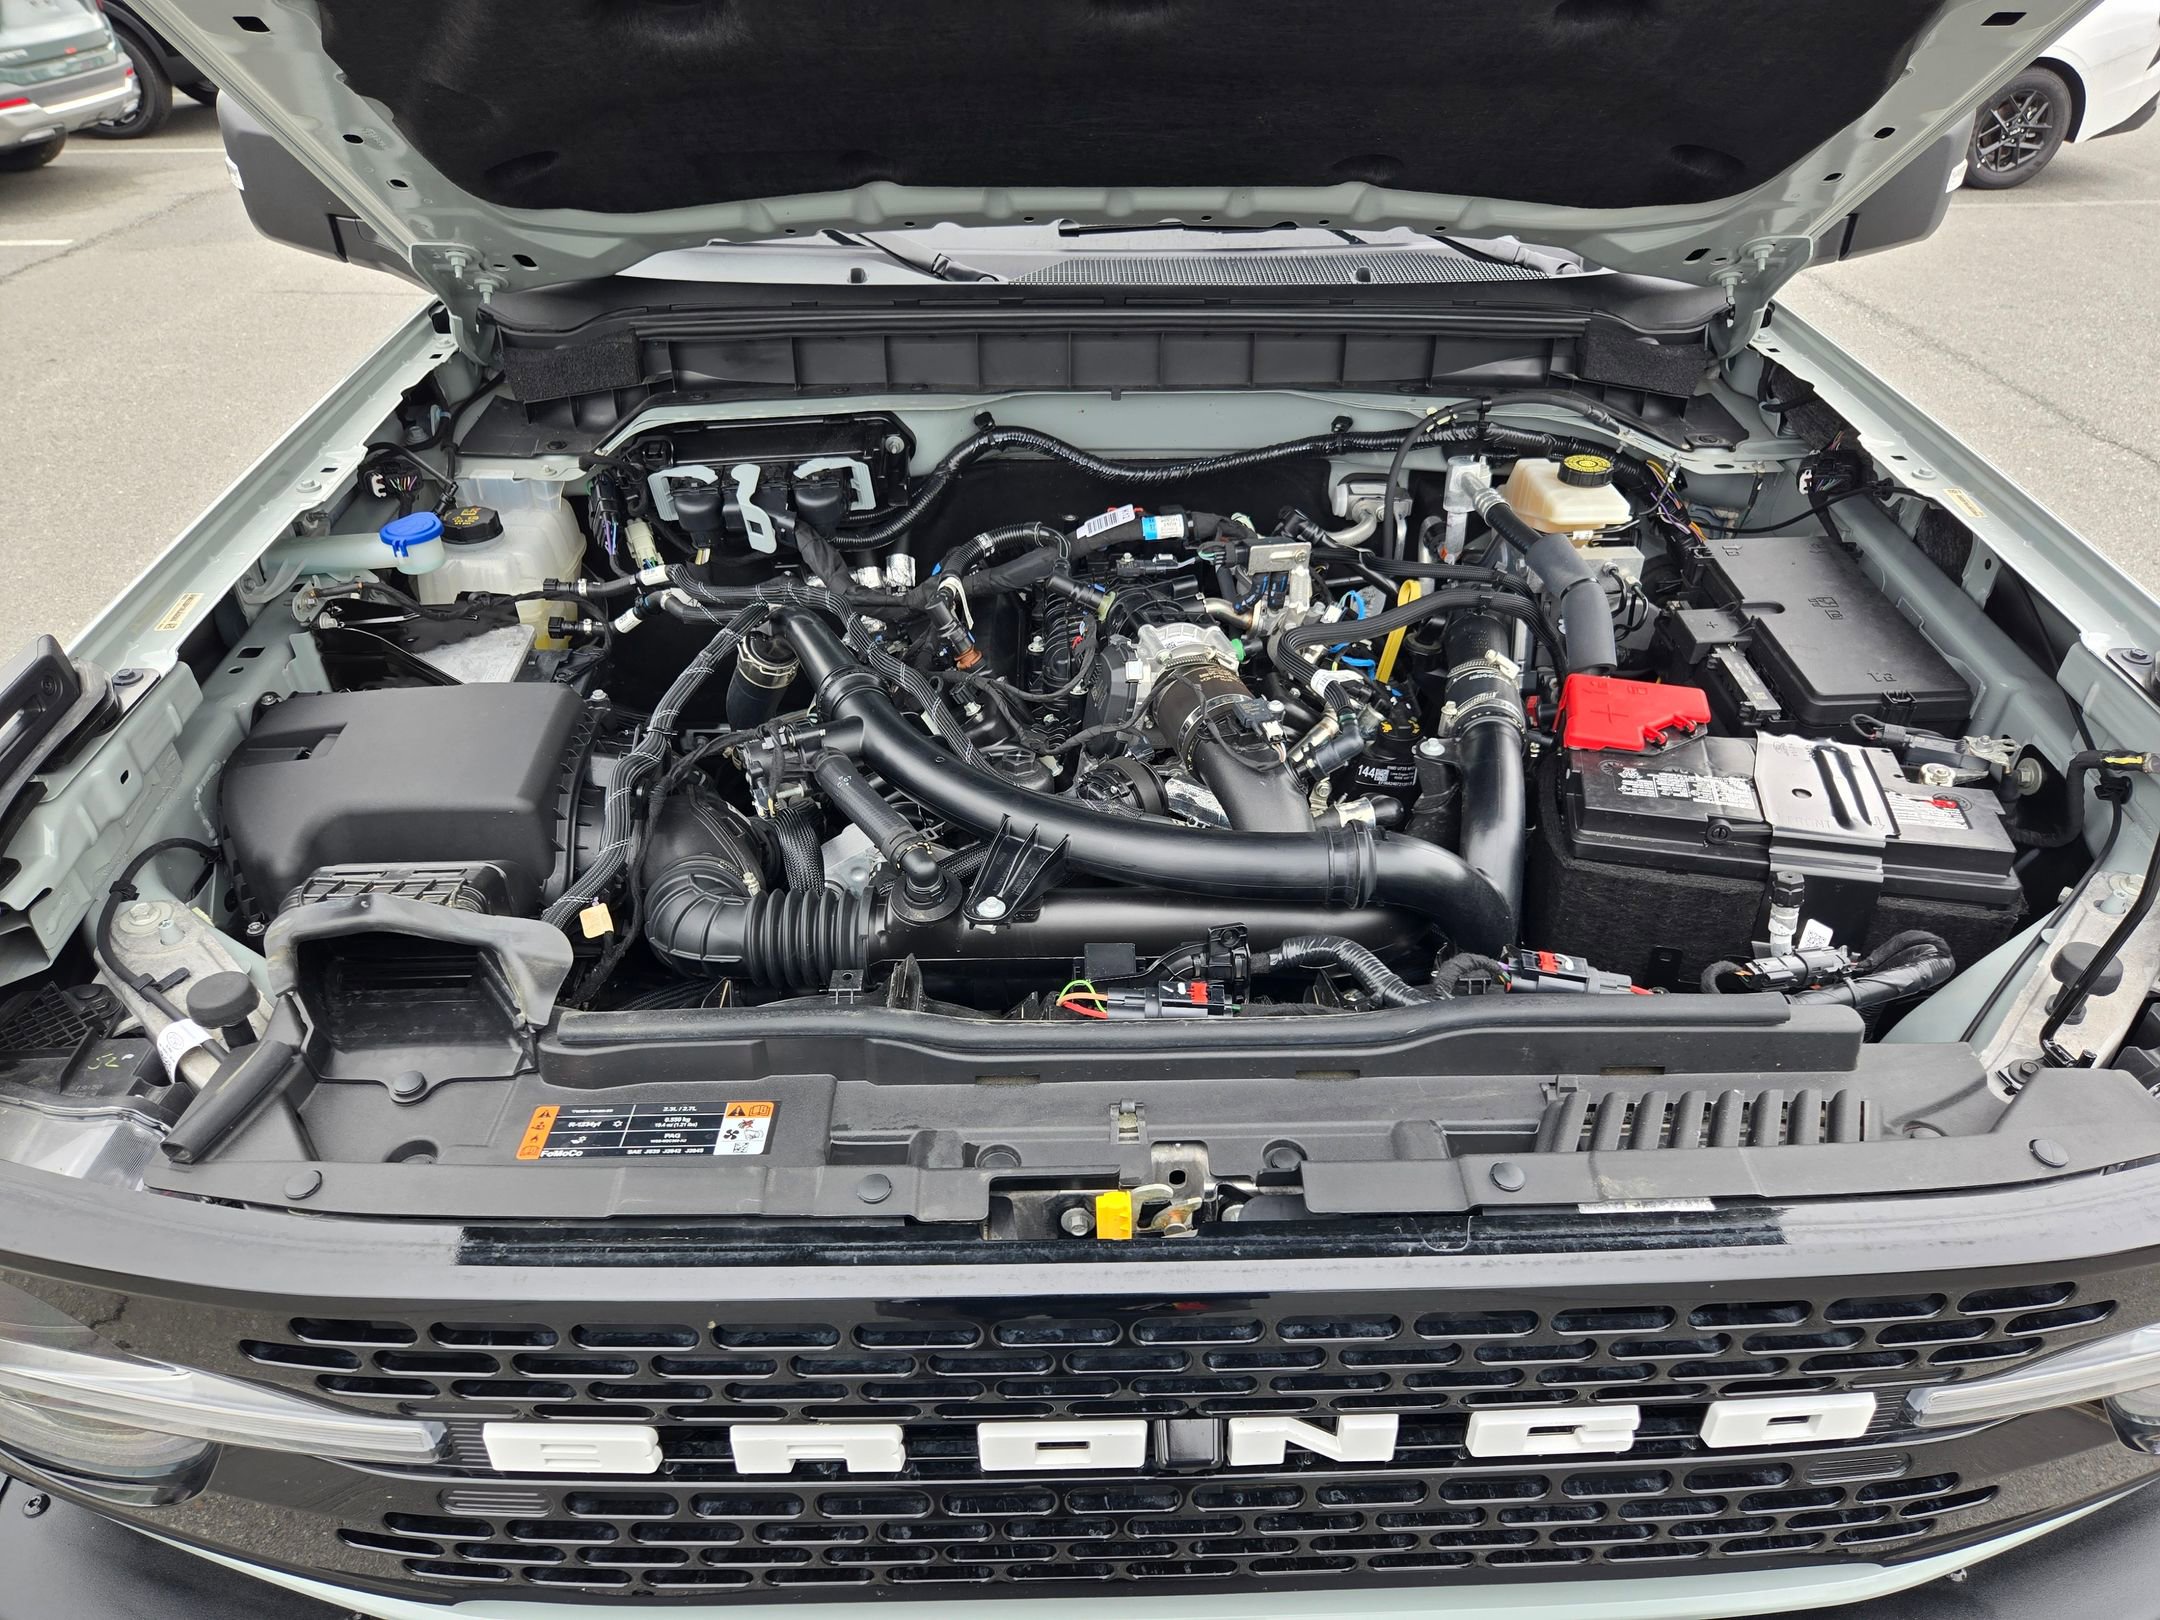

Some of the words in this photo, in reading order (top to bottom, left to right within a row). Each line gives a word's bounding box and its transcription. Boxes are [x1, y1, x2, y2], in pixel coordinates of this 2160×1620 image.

[1358, 764, 1375, 778] 144
[540, 1149, 583, 1158] FoMoCo
[483, 1391, 1877, 1476] BRONCO
